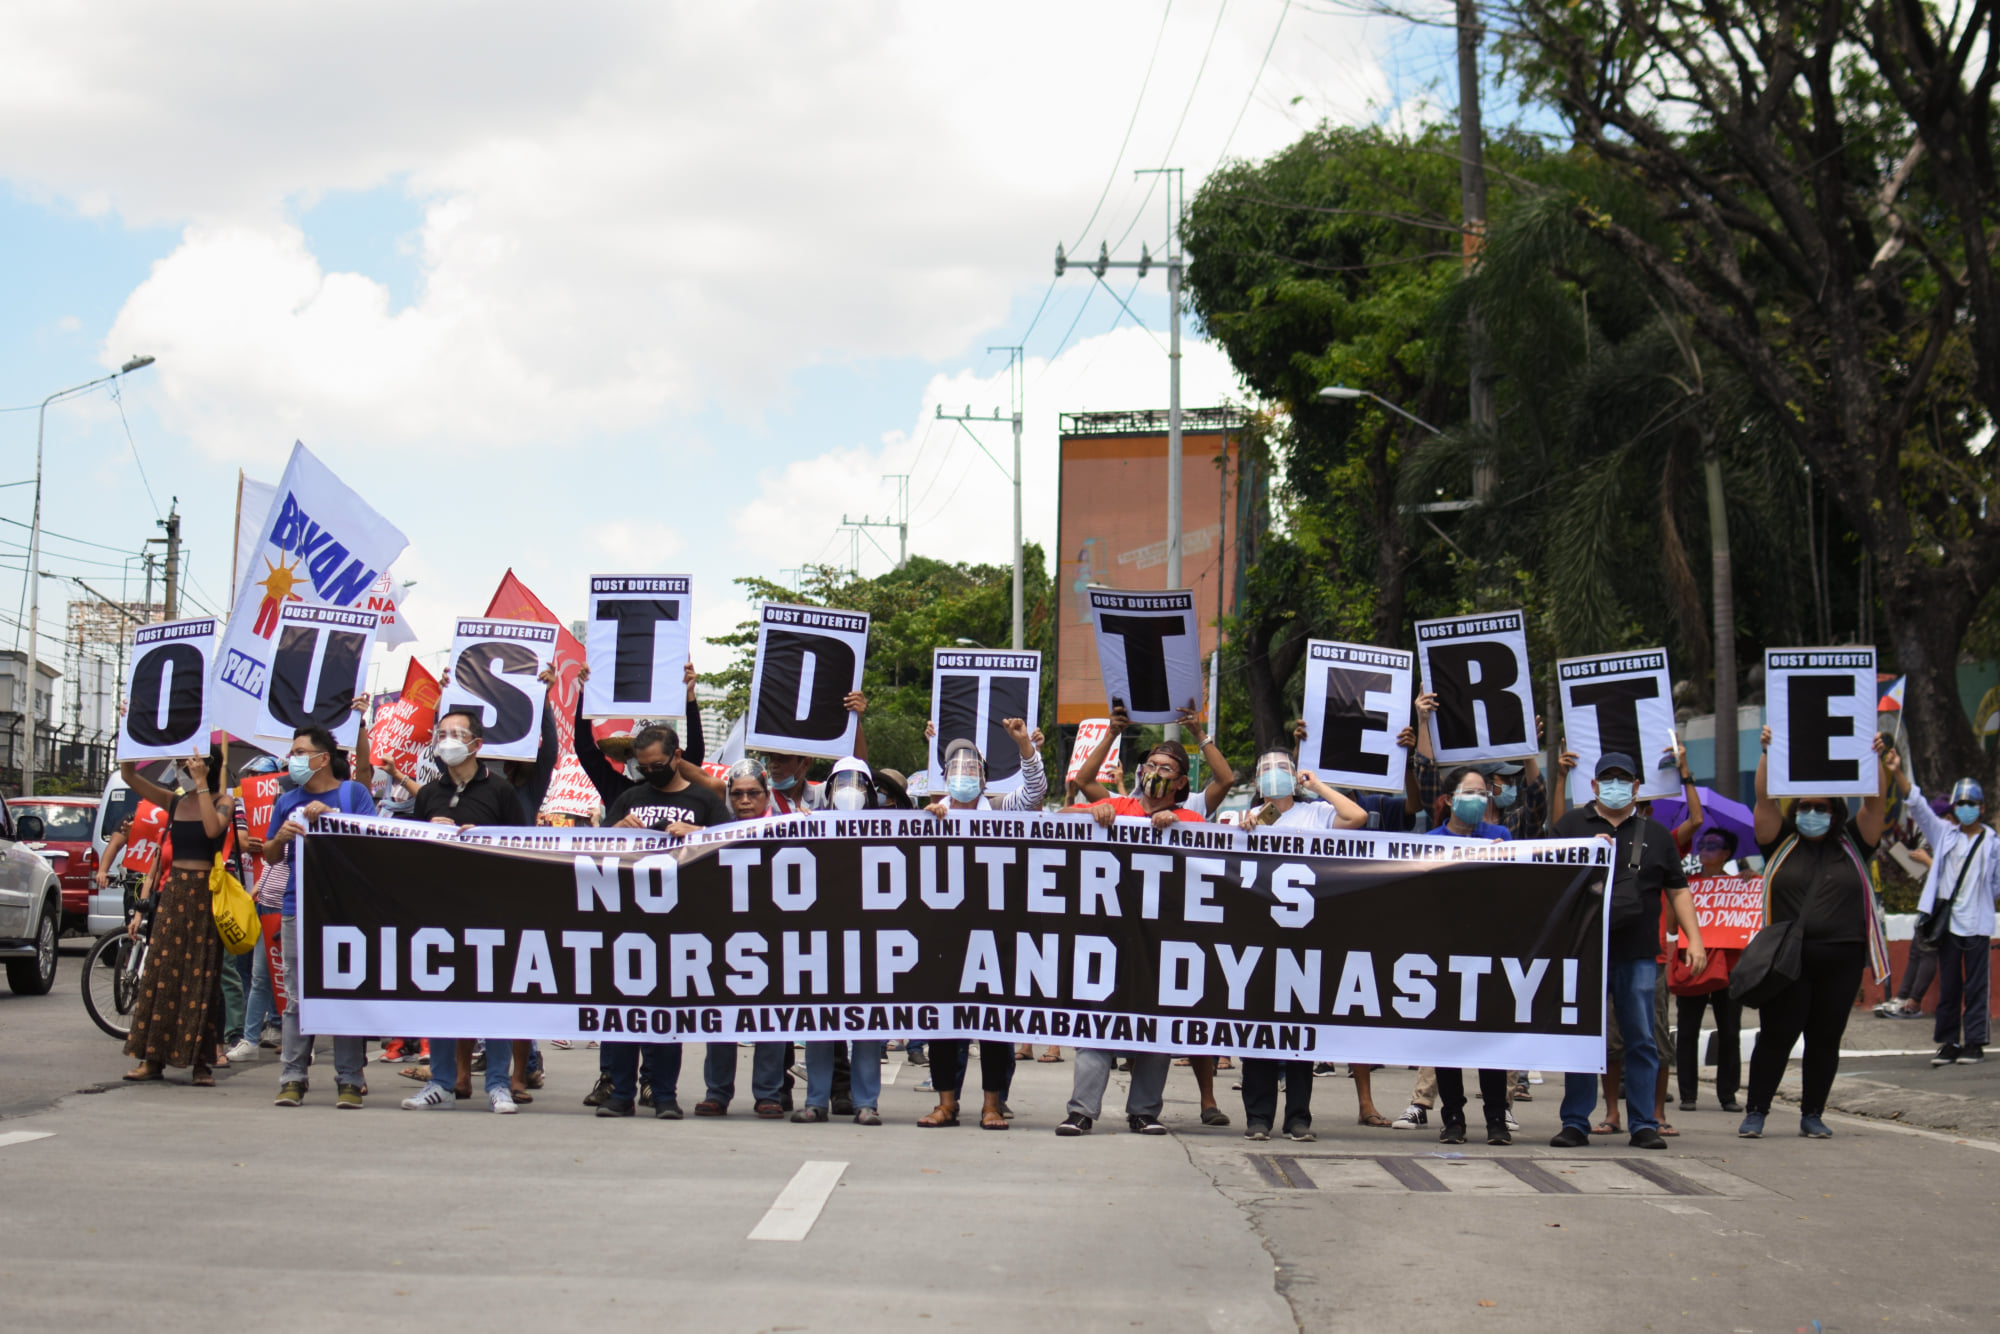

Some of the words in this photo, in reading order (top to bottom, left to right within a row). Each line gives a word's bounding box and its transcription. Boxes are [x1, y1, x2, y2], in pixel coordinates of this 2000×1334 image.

[593, 580, 625, 591] OUST
[627, 580, 687, 592] DUTERTE!
[1093, 594, 1125, 607] OUST
[1127, 595, 1188, 609] DUTERTE!
[284, 606, 316, 620] OUST
[318, 609, 375, 627] DUTERTE!
[766, 609, 800, 624] OUST
[802, 612, 864, 630] DUTERTE!
[1420, 623, 1454, 638] OUST
[1456, 616, 1519, 635] DUTERTE!
[138, 627, 164, 642] OUST
[164, 620, 213, 639] DUTERTE!
[459, 623, 492, 637] OUST
[493, 625, 553, 641] DUTERTE!
[596, 599, 680, 703] T
[939, 655, 973, 667] OUST
[974, 656, 1036, 669] DUTERTE!
[1100, 613, 1186, 712] T
[1312, 646, 1347, 661] OUST
[1348, 649, 1409, 668] DUTERTE!
[1769, 654, 1803, 667] OUST
[1805, 654, 1871, 667] DUTERTE!
[1562, 663, 1597, 677] OUST
[1599, 653, 1663, 673] DUTERTE!
[126, 643, 204, 747] O
[755, 629, 856, 741] D
[1427, 641, 1526, 750] R
[1319, 667, 1393, 776] E
[1788, 675, 1860, 782] E
[630, 805, 695, 824] HUSTISYA
[365, 822, 428, 839] AGAIN!
[499, 835, 561, 850] AGAIN!
[571, 836, 627, 851] NEVER
[763, 820, 827, 838] AGAIN!
[835, 818, 892, 837] NEVER
[898, 818, 961, 837] AGAIN!
[969, 819, 1026, 838] NEVER
[1030, 821, 1093, 840] AGAIN!
[1106, 823, 1163, 845] NEVER
[1168, 828, 1234, 850] AGAIN!
[1246, 833, 1305, 854] NEVER
[1309, 837, 1375, 858] AGAIN!
[1388, 842, 1445, 862] NEVER
[1450, 846, 1517, 863] AGAIN!
[1531, 845, 1590, 864] NEVER
[574, 854, 679, 914] NO
[718, 847, 817, 912] TO
[861, 845, 1317, 929] DUTERTE'S
[225, 925, 245, 943] 15
[322, 925, 919, 998] DICTATORSHIP
[958, 929, 1117, 1001] AND
[1157, 940, 1578, 1025] DYNASTY!
[579, 1007, 723, 1034] BAGONG
[735, 1005, 940, 1033] ALYANSANG
[952, 1005, 1157, 1042] MAKABAYAN
[1170, 1019, 1316, 1052] (BAYAN)
